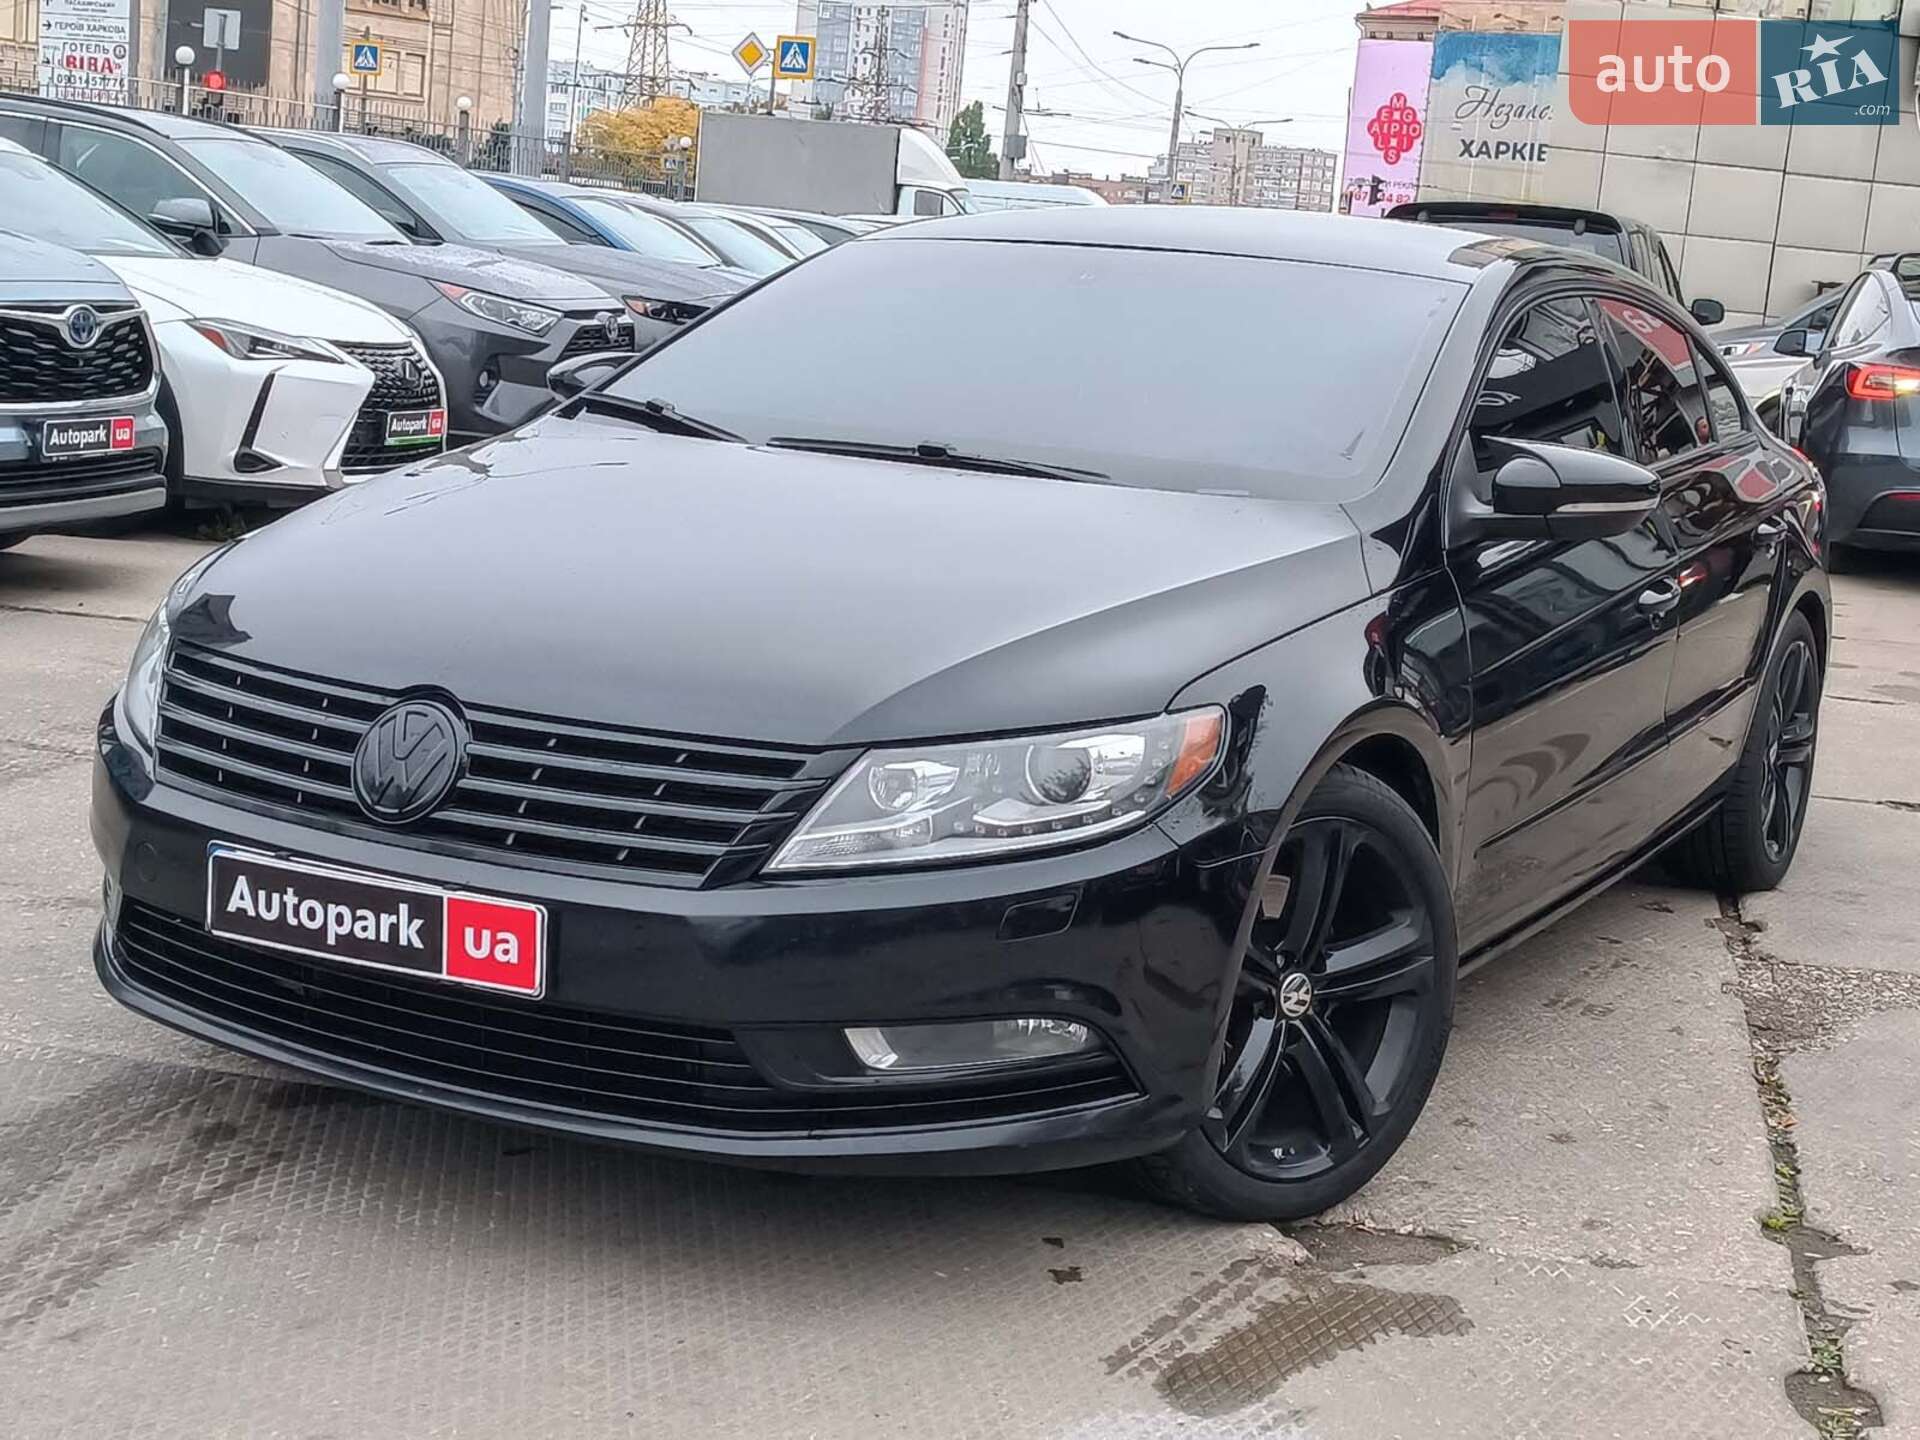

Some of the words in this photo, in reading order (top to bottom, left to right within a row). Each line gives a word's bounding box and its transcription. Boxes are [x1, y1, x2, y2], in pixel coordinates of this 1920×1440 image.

[86, 24, 126, 34] ХАРКОВА
[62, 41, 110, 55] ГОТЕЛЬ
[1455, 85, 1553, 130] Незале
[391, 414, 427, 435] Autopark
[49, 424, 107, 449] Autopark
[116, 428, 130, 441] ua
[226, 875, 425, 949] Autopark
[463, 927, 519, 964] ua
